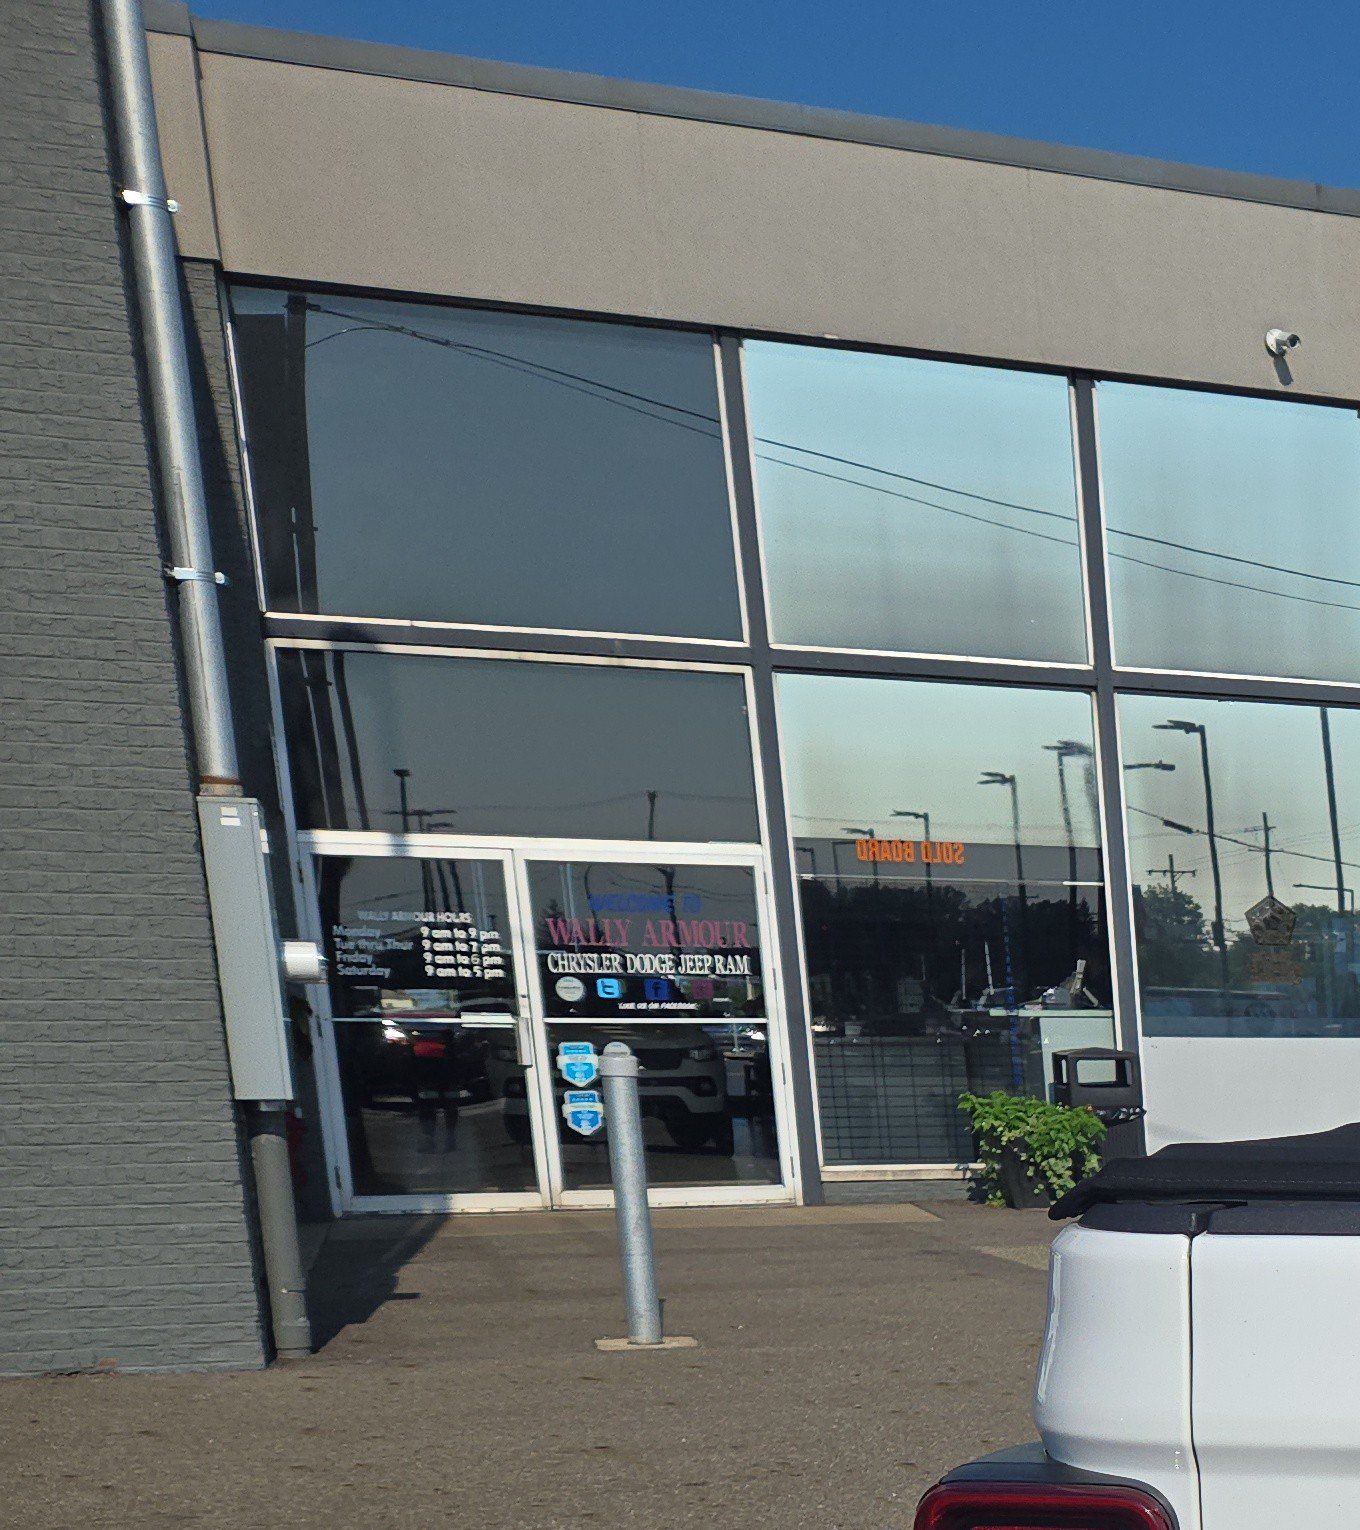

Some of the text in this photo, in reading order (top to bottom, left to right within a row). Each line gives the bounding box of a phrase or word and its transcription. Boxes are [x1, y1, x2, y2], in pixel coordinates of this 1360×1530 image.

[545, 917, 750, 949] WALLY ARMOUR
[547, 952, 752, 975] CHRYSLER DODGE JEEP RAM
